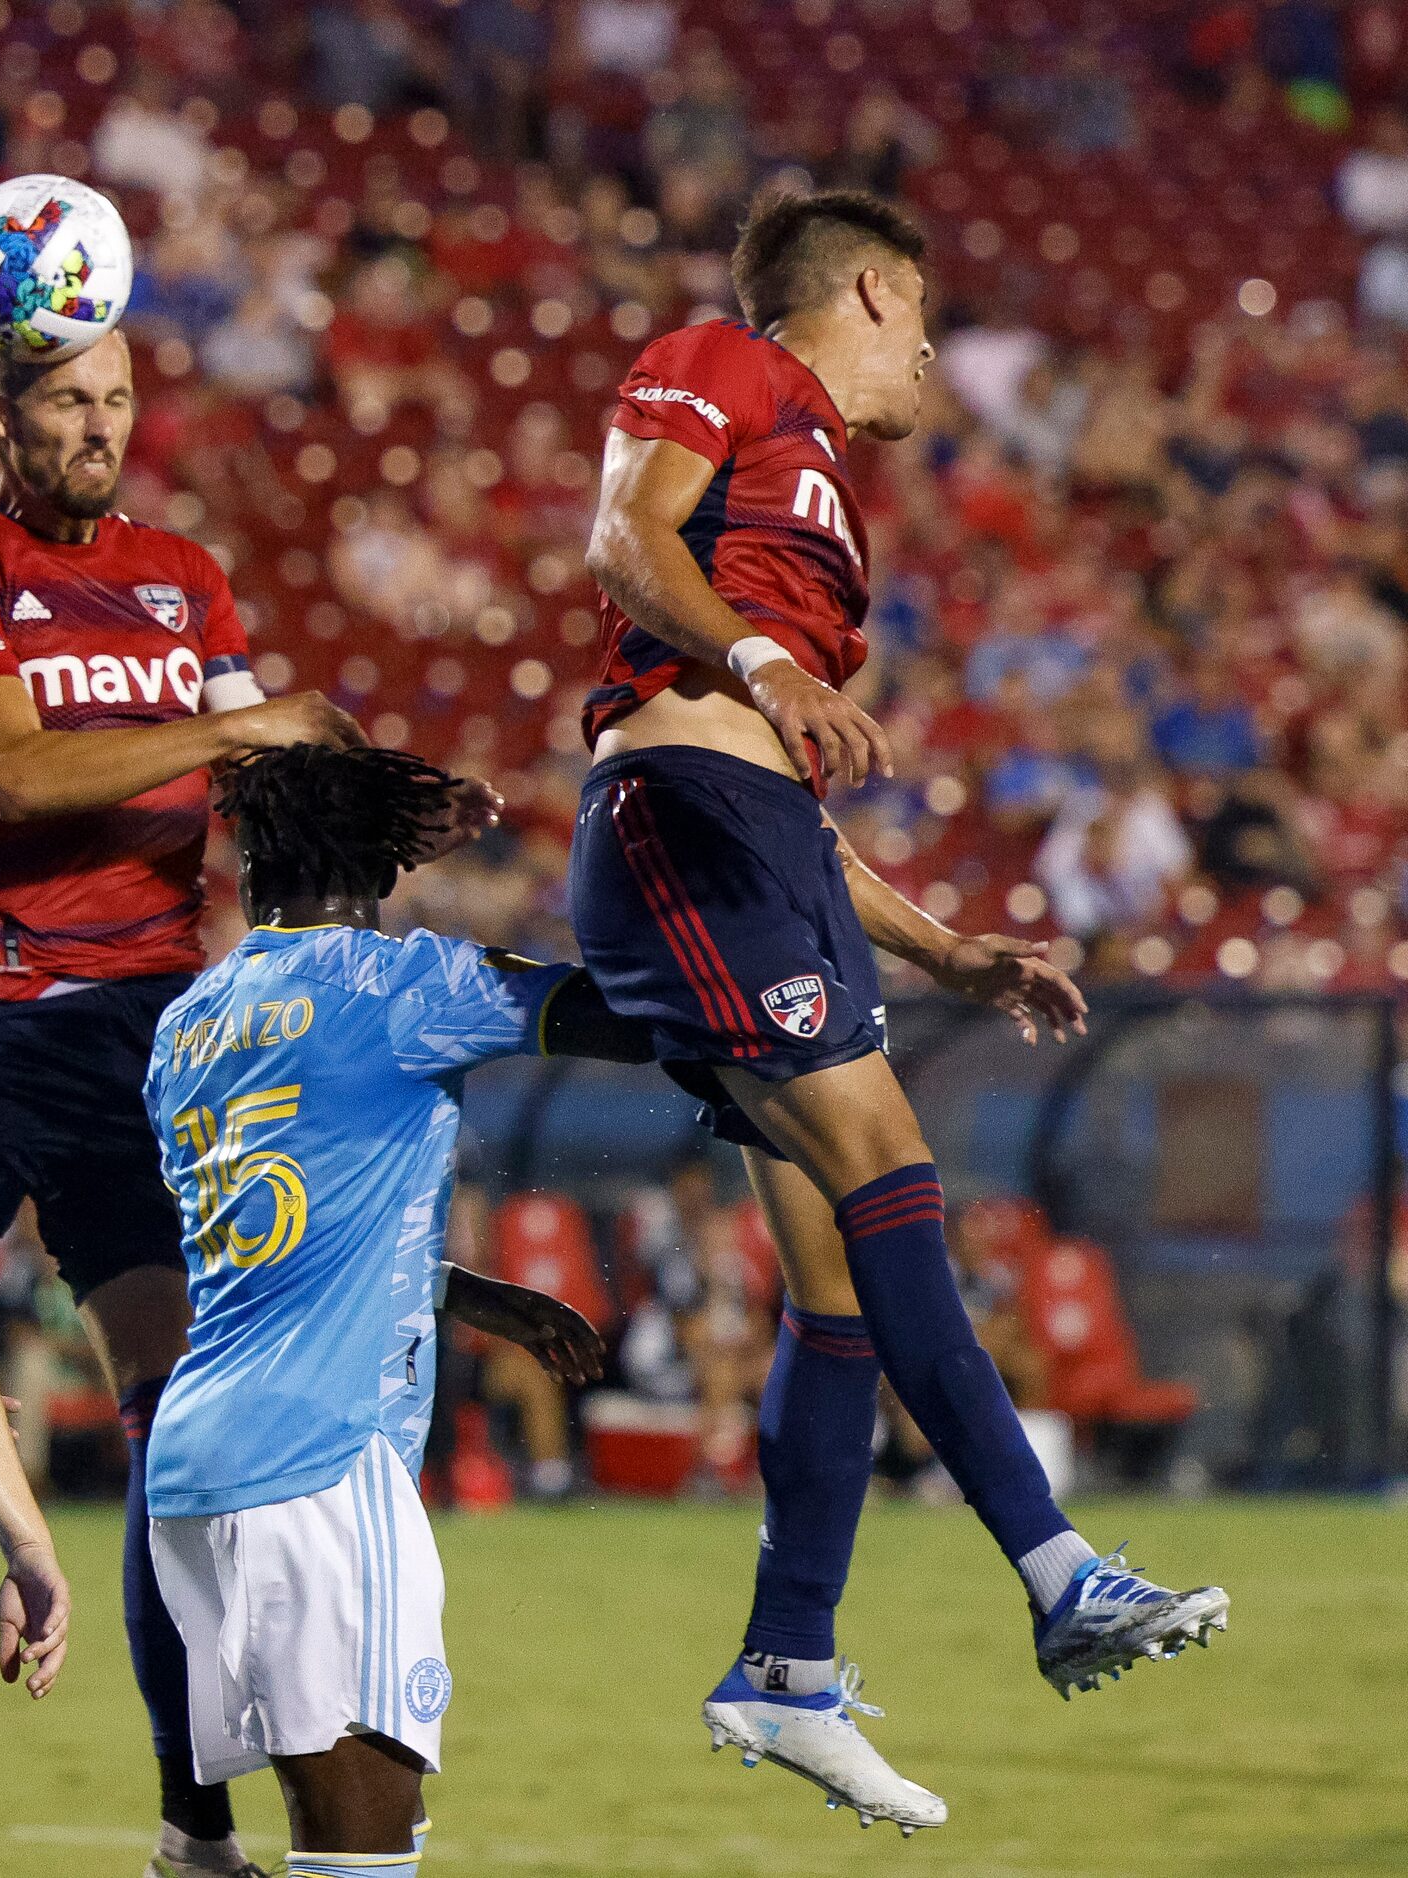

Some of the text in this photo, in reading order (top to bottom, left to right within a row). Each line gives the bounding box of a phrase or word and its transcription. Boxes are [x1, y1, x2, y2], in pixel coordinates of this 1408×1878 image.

[628, 386, 731, 430] ADVOCARE
[767, 979, 819, 1007] FC DALLAS
[172, 996, 314, 1074] MBAIZO
[172, 1083, 308, 1275] 15
